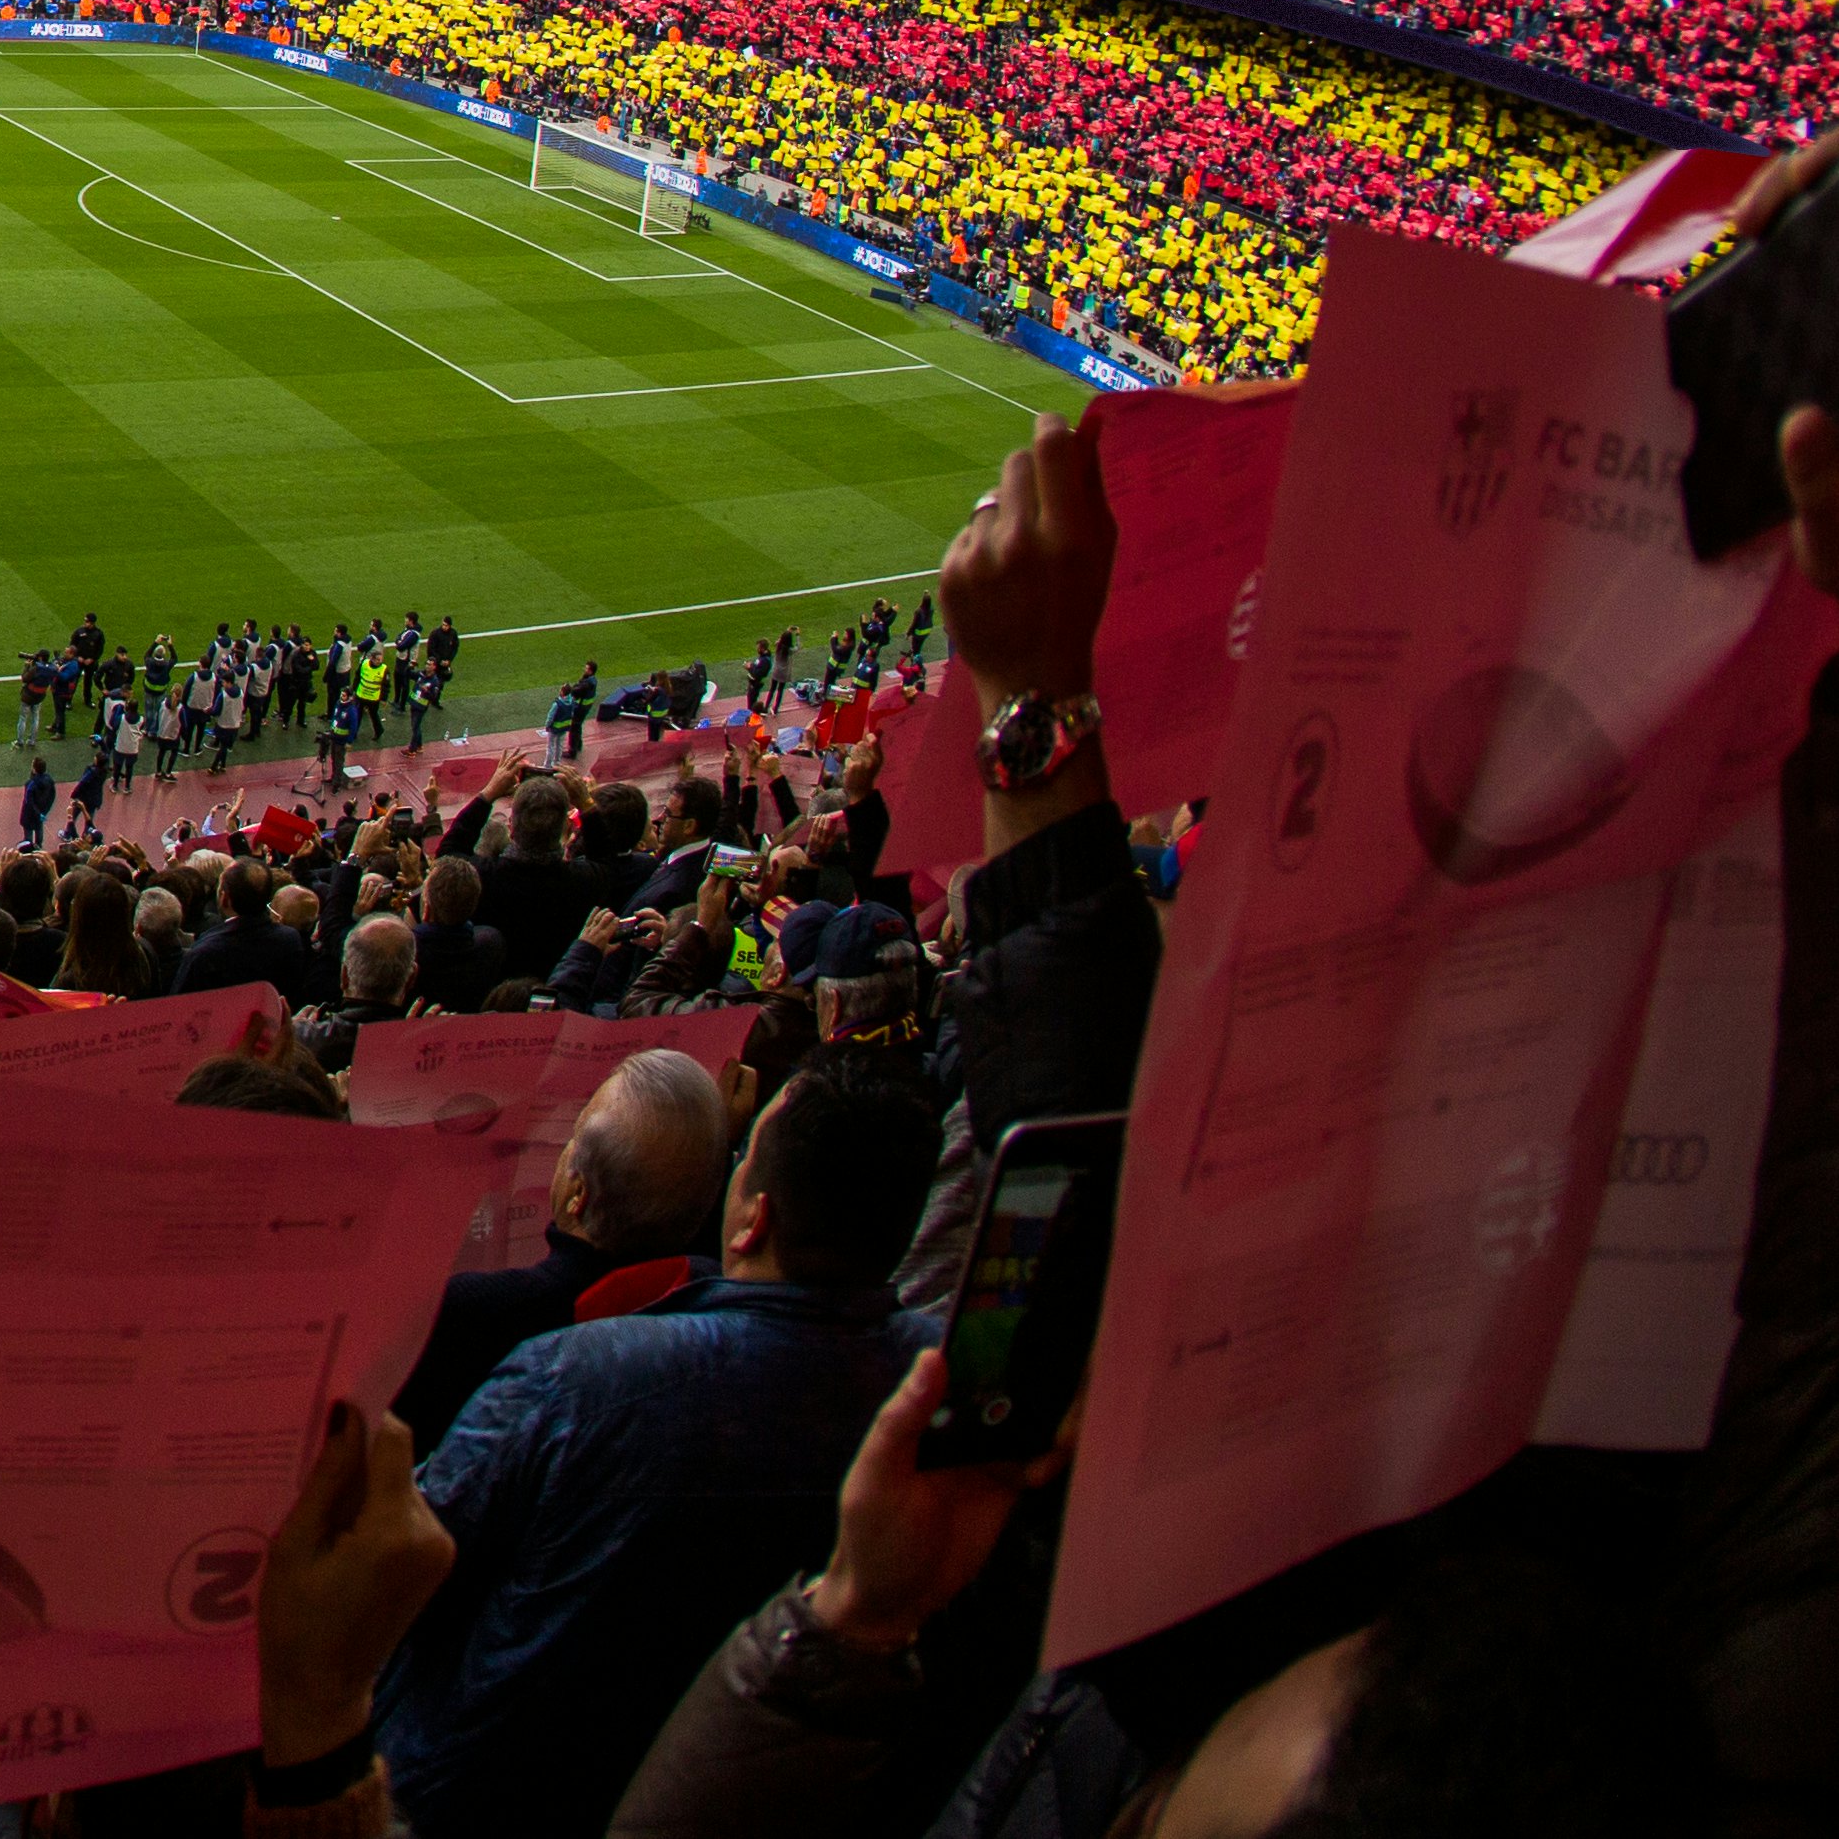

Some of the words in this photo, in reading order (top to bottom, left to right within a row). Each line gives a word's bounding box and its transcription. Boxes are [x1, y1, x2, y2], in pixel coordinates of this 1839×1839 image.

[1279, 733, 1329, 840] 2
[117, 1021, 173, 1041] MADRID
[194, 1549, 264, 1625] 2
